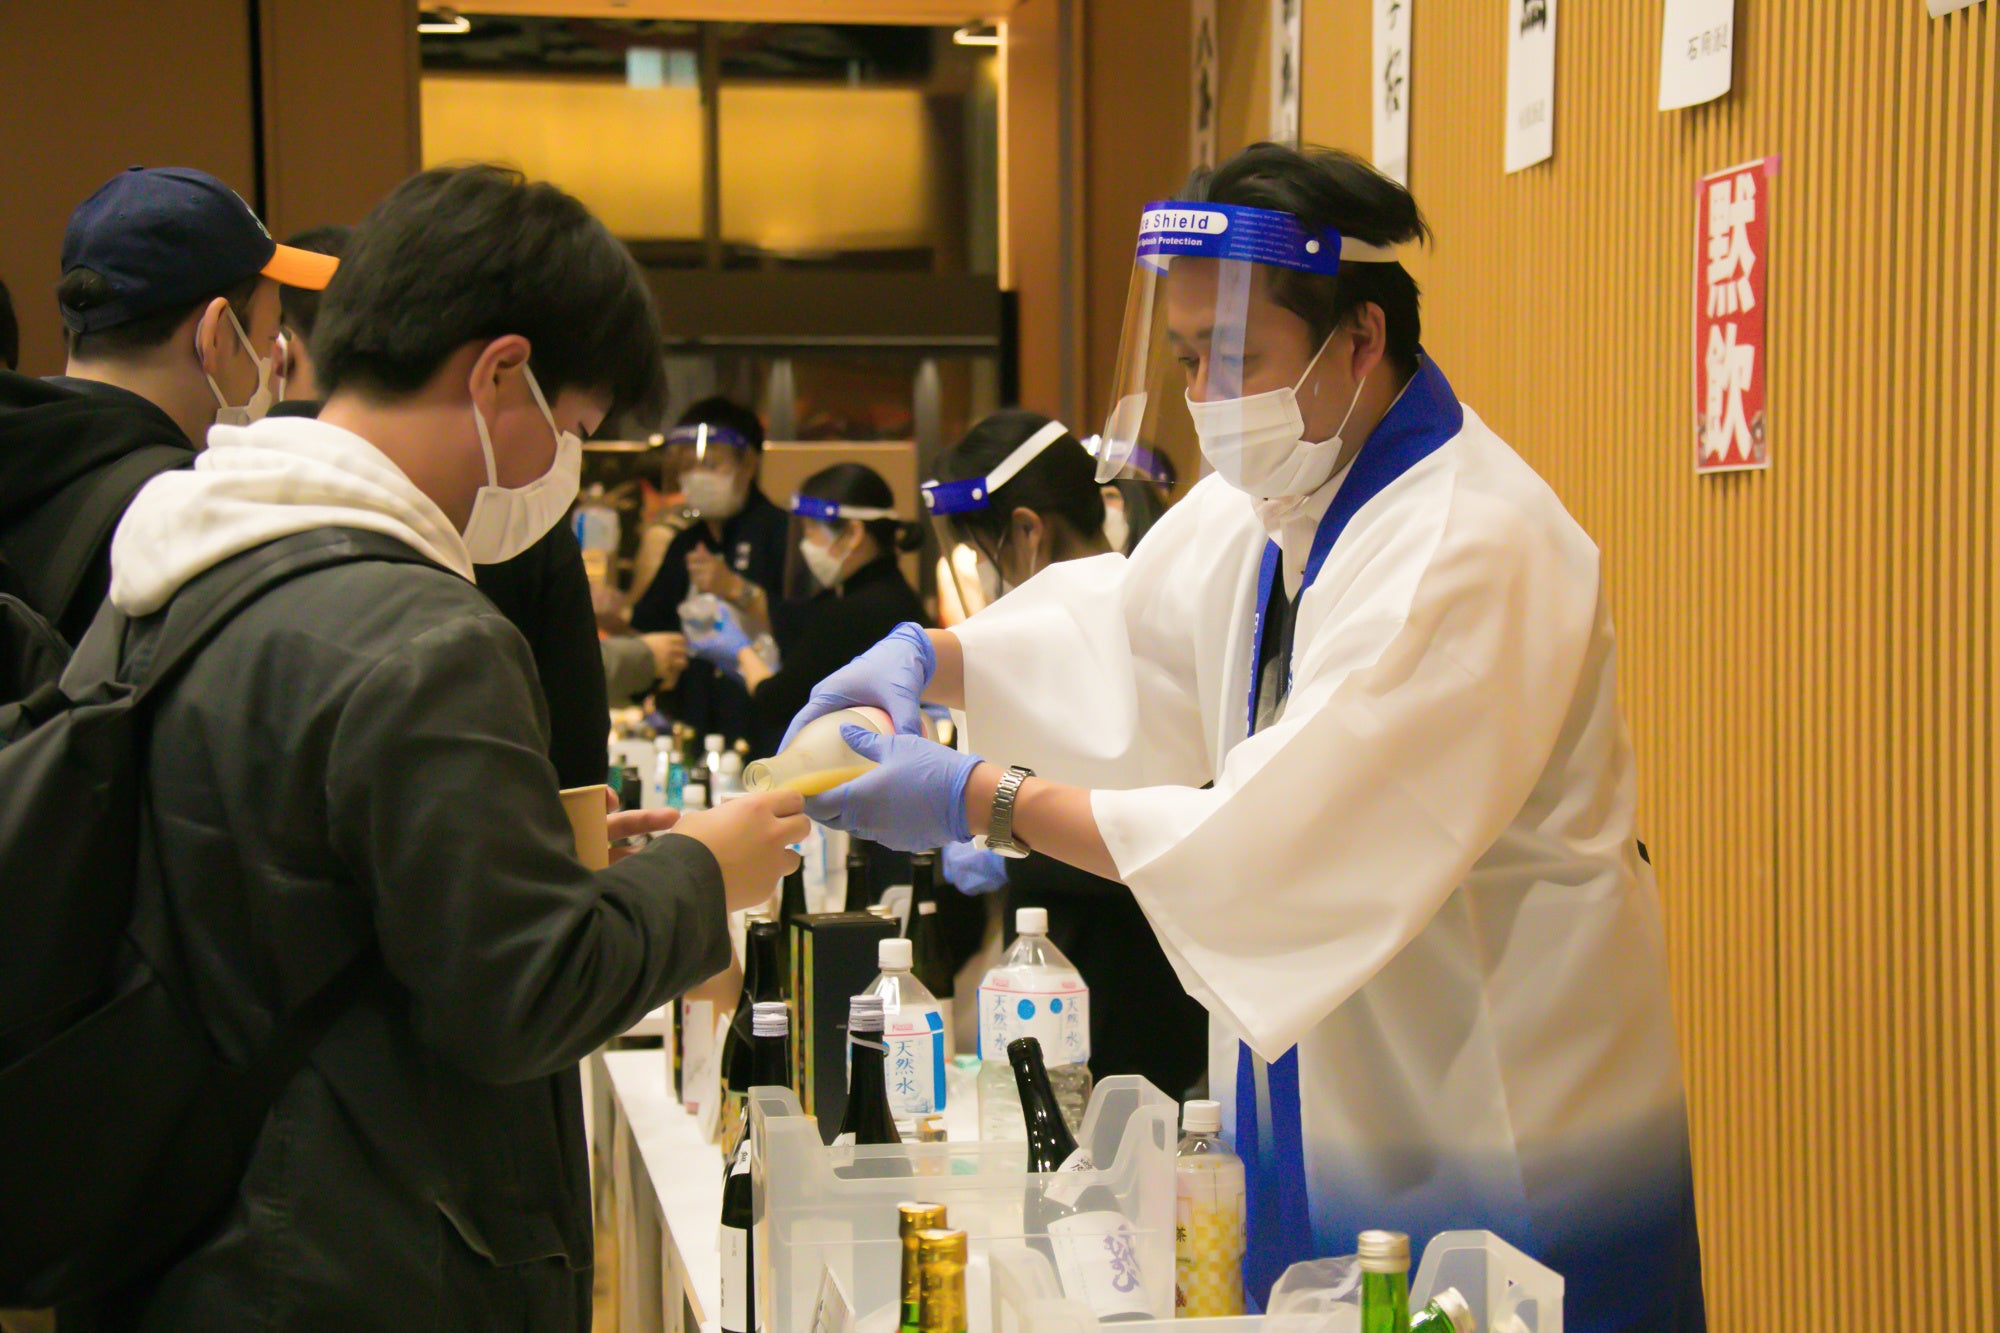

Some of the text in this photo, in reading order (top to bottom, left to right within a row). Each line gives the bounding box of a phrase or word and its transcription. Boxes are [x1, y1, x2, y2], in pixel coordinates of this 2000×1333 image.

[1153, 213, 1210, 230] Shield
[1158, 235, 1203, 247] Protection
[1704, 171, 1757, 463] 黙飲
[991, 994, 1008, 1052] 天然水
[1065, 996, 1079, 1048] 天然水
[895, 1040, 915, 1096] 天然水
